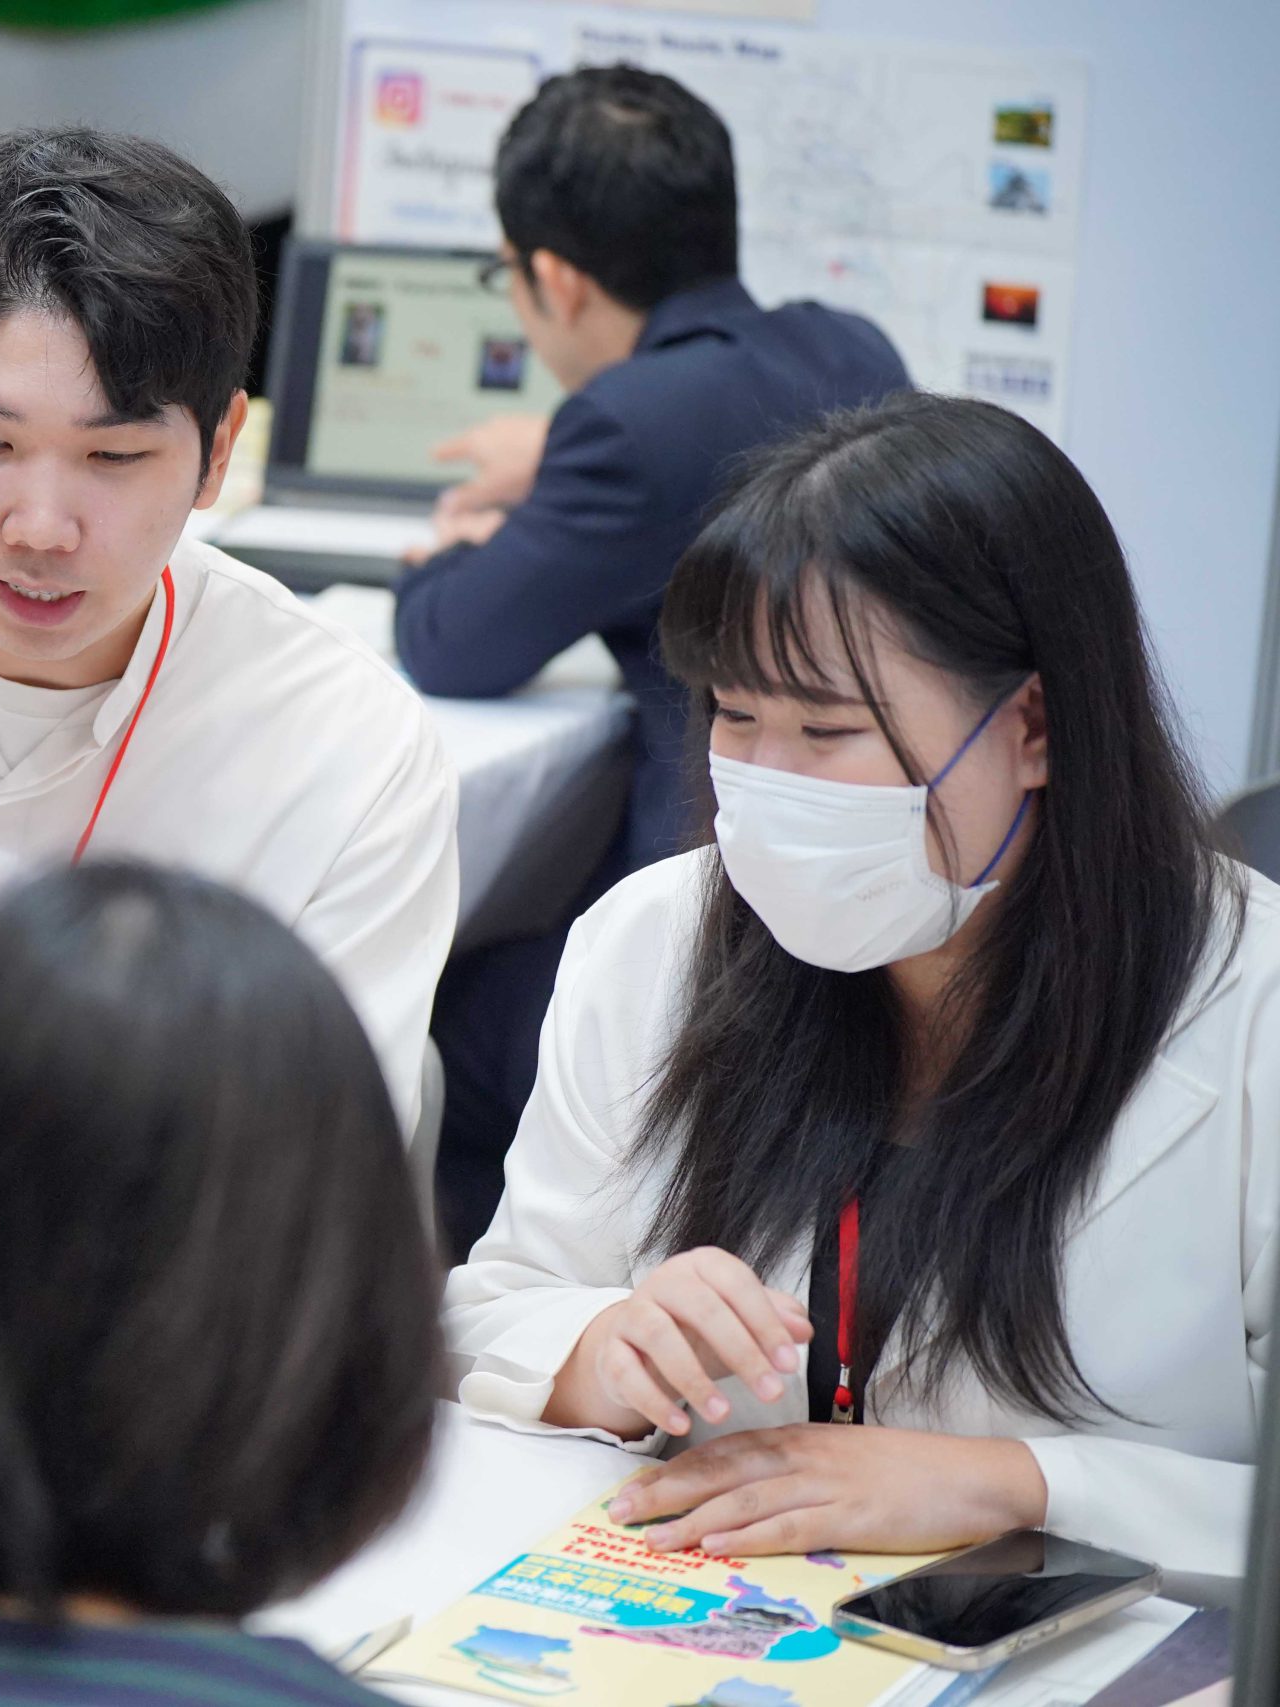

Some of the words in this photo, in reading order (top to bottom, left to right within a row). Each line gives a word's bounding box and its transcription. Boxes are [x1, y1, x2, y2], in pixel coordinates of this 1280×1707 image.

[563, 1544, 585, 1556] is
[572, 1537, 627, 1552] you
[633, 1550, 706, 1570] need
